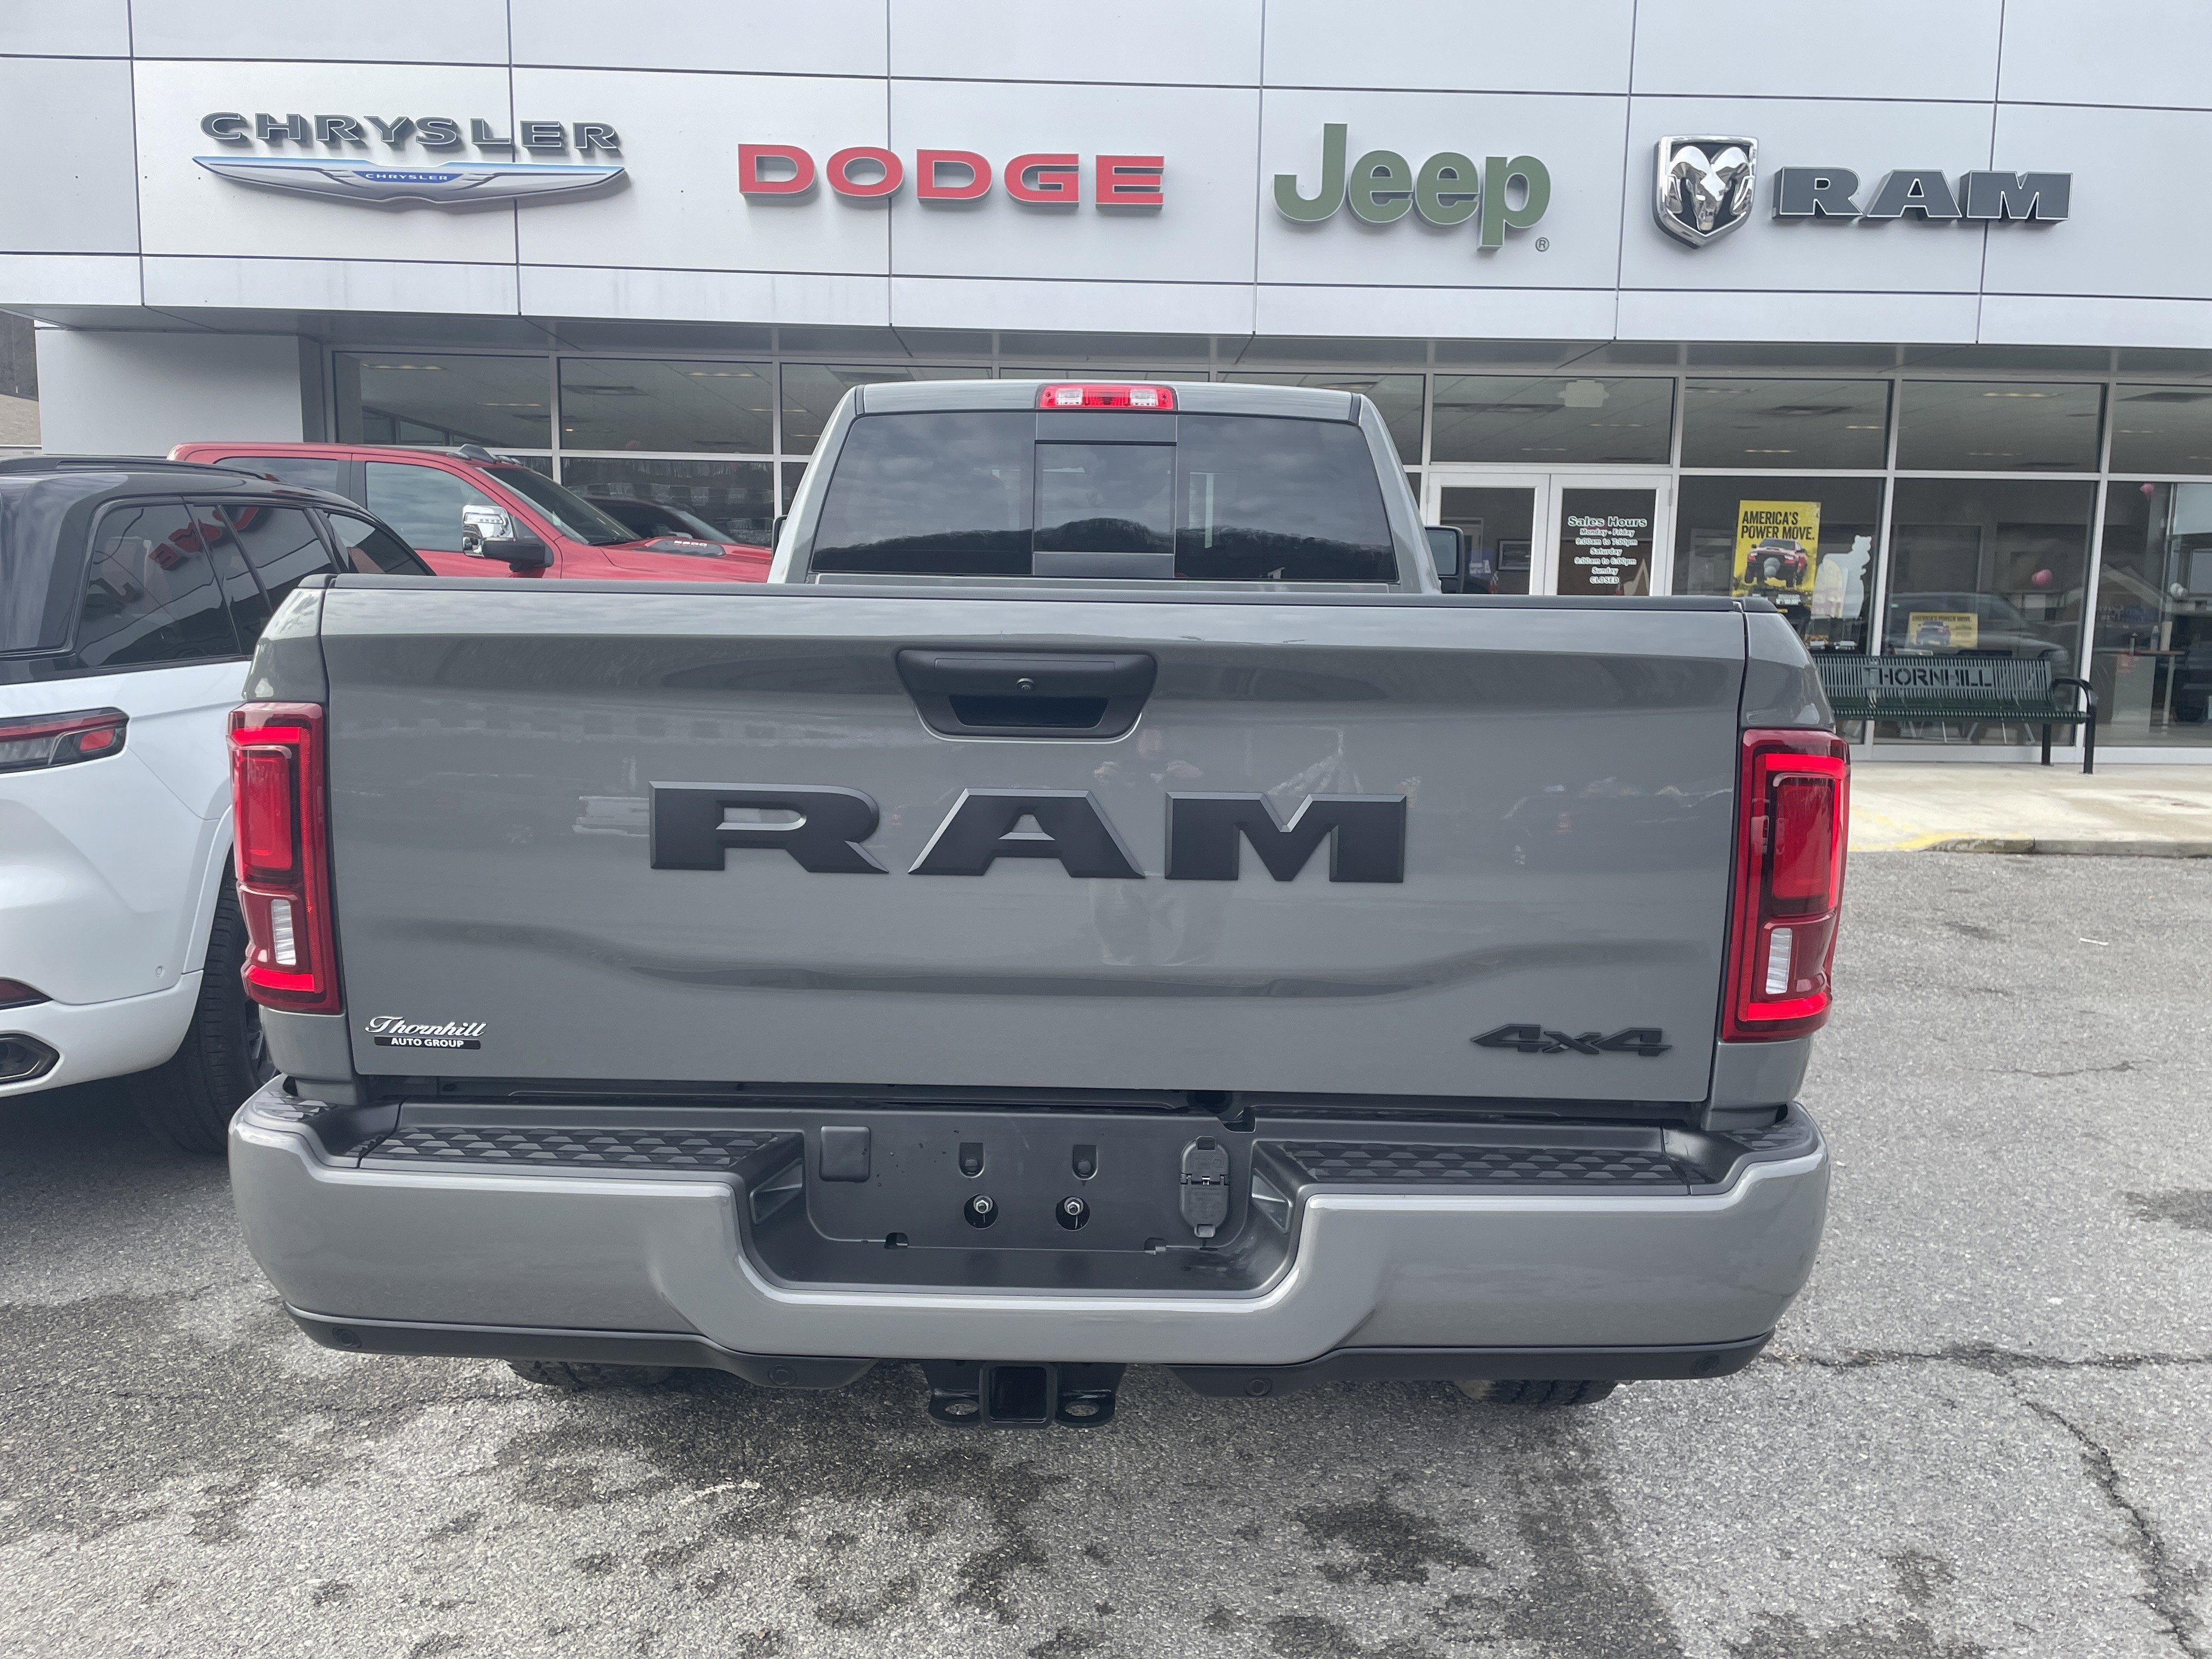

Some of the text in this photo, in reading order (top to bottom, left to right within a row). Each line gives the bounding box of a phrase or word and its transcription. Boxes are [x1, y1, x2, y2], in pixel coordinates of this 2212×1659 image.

[200, 112, 621, 152] CHRYSLER
[738, 143, 1165, 208] DODGE
[1272, 122, 1551, 250] Jeep
[1774, 166, 2074, 221] RAM
[1567, 516, 1647, 527] Sales Hours
[1742, 511, 1798, 525] AMERICA'S
[1741, 525, 1815, 540] POWER MOVE.
[1602, 538, 1611, 546] to
[1590, 548, 1622, 557] Saturday
[1601, 557, 1610, 565] to
[1591, 566, 1618, 575] Sunday
[1590, 576, 1620, 584] CLOSED
[648, 780, 1408, 883] RAM
[365, 1015, 487, 1037] Thornhill
[391, 1037, 464, 1048] AUTO GROUP
